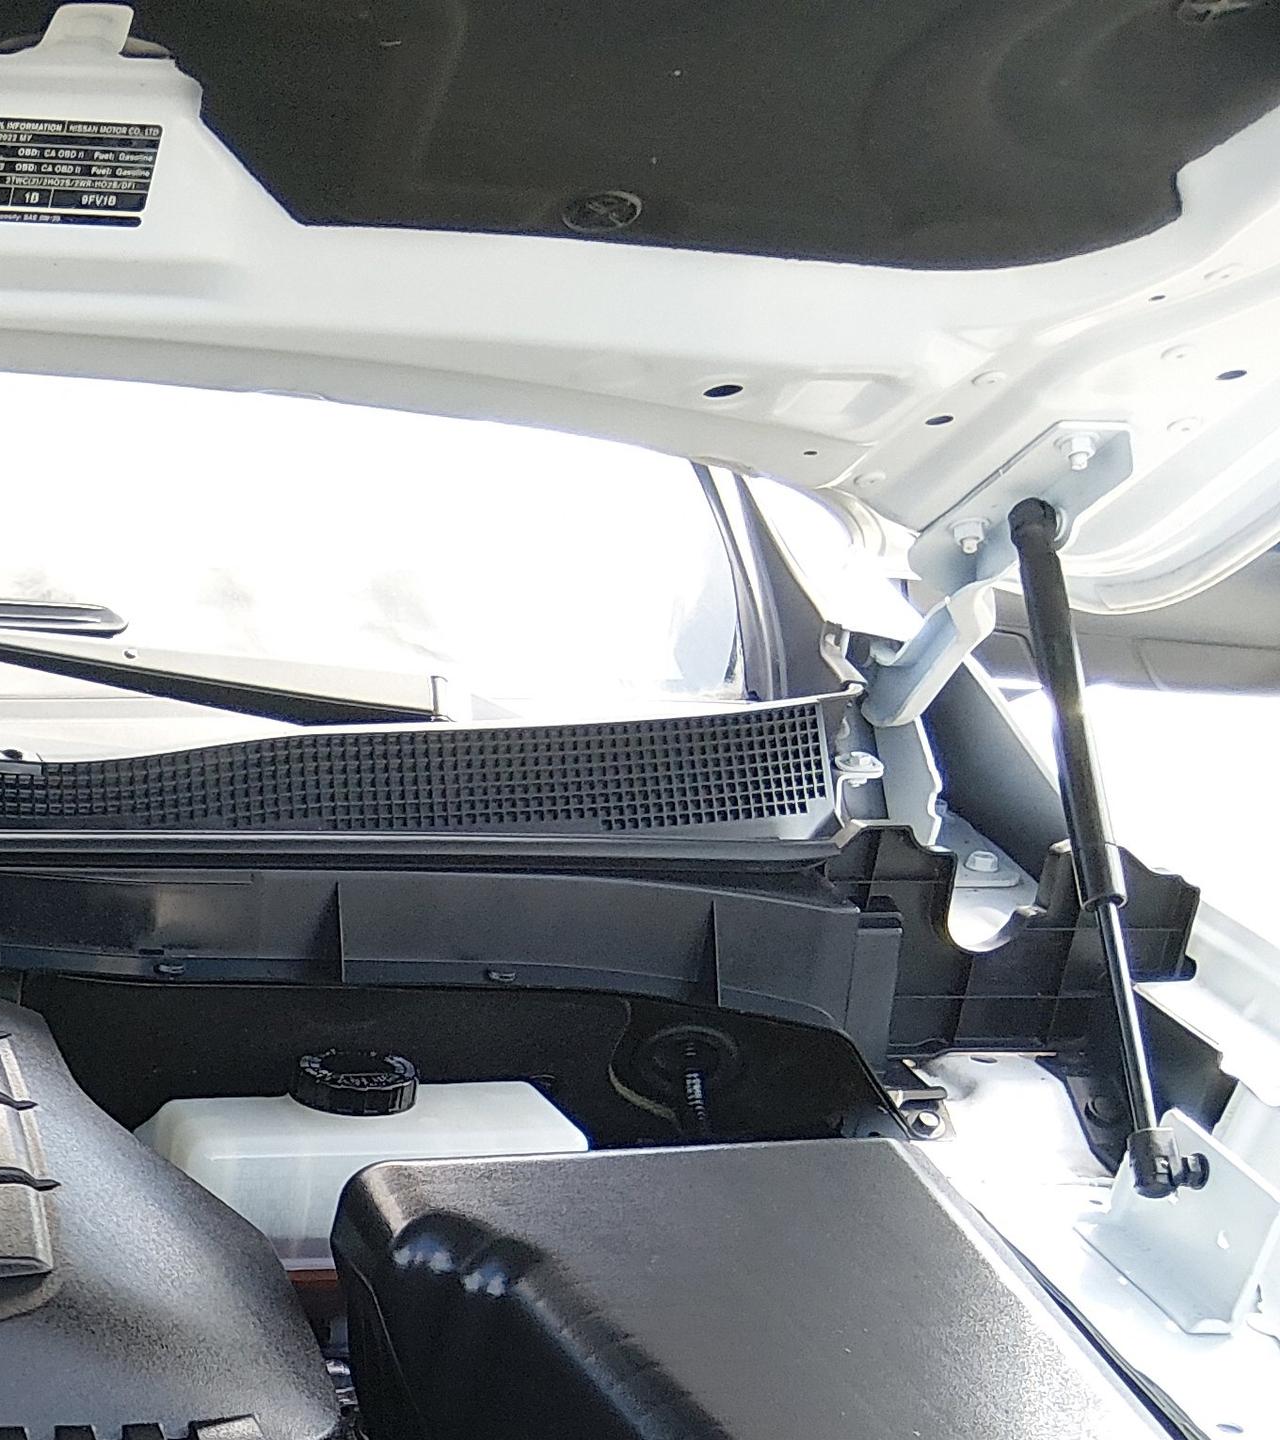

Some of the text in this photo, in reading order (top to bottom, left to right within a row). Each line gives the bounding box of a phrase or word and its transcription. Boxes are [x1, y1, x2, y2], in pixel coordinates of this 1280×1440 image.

[7, 121, 63, 132] INFORMATION
[69, 124, 99, 134] NISSAN
[100, 125, 127, 135] MOTOR
[19, 134, 33, 142] MY
[18, 147, 40, 157] OBD:
[44, 149, 56, 158] CA
[57, 150, 77, 159] OBD
[93, 151, 153, 162] Fuel: Gasoline
[15, 162, 37, 172] OBD:
[40, 164, 53, 173] CA
[54, 165, 74, 174] OBD
[91, 166, 151, 177] Fuel: Gasoline
